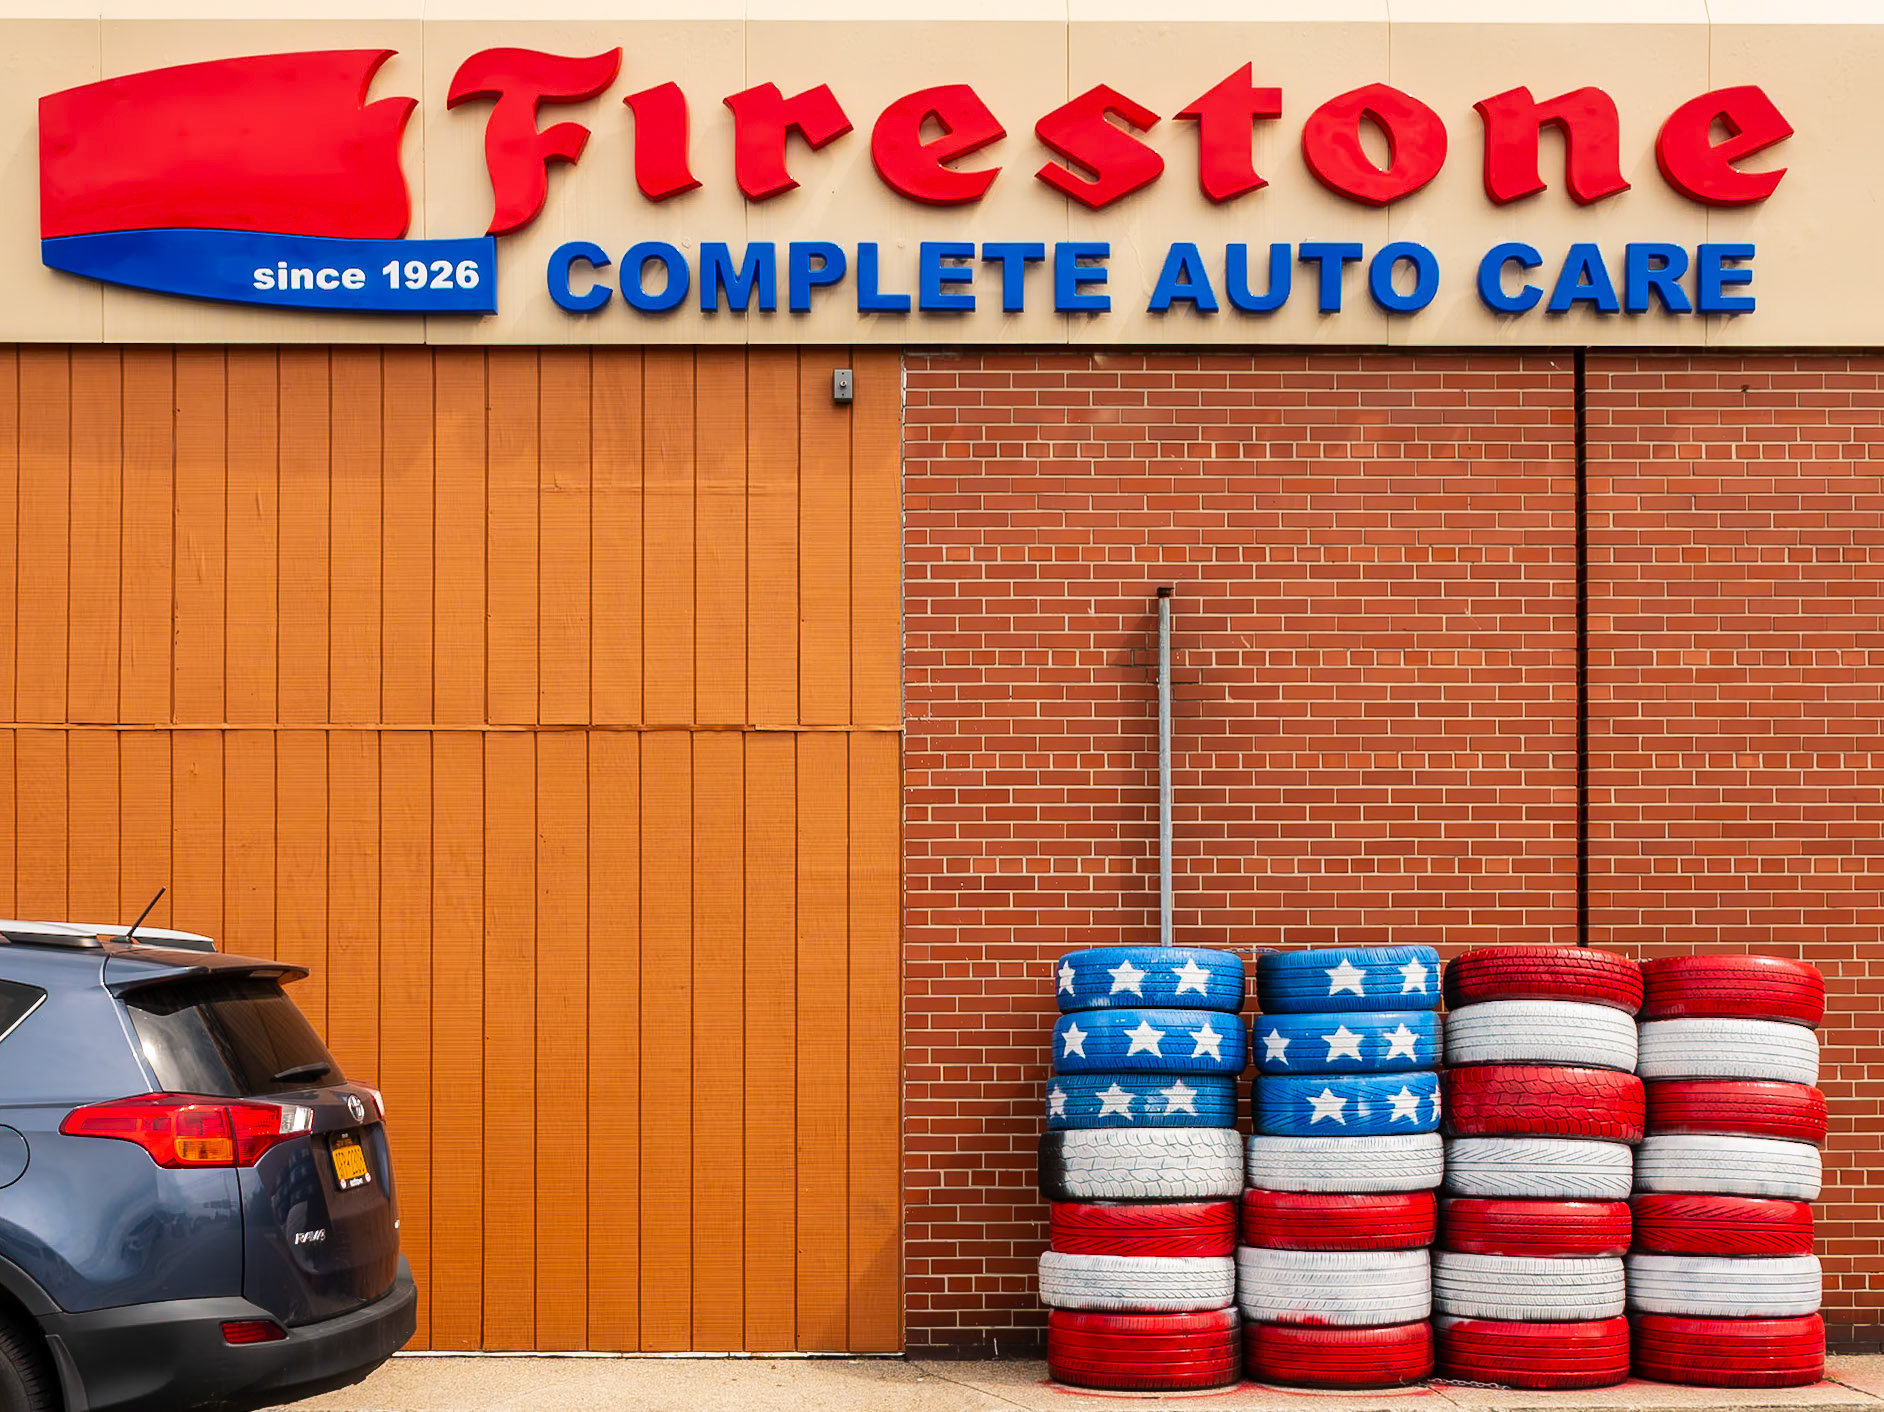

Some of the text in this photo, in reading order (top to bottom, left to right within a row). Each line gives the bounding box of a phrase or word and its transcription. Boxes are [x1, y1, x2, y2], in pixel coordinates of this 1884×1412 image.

[446, 46, 1795, 235] Firestone
[252, 259, 481, 291] since 1926
[546, 240, 1757, 316] COMPLETE AUTO CARE
